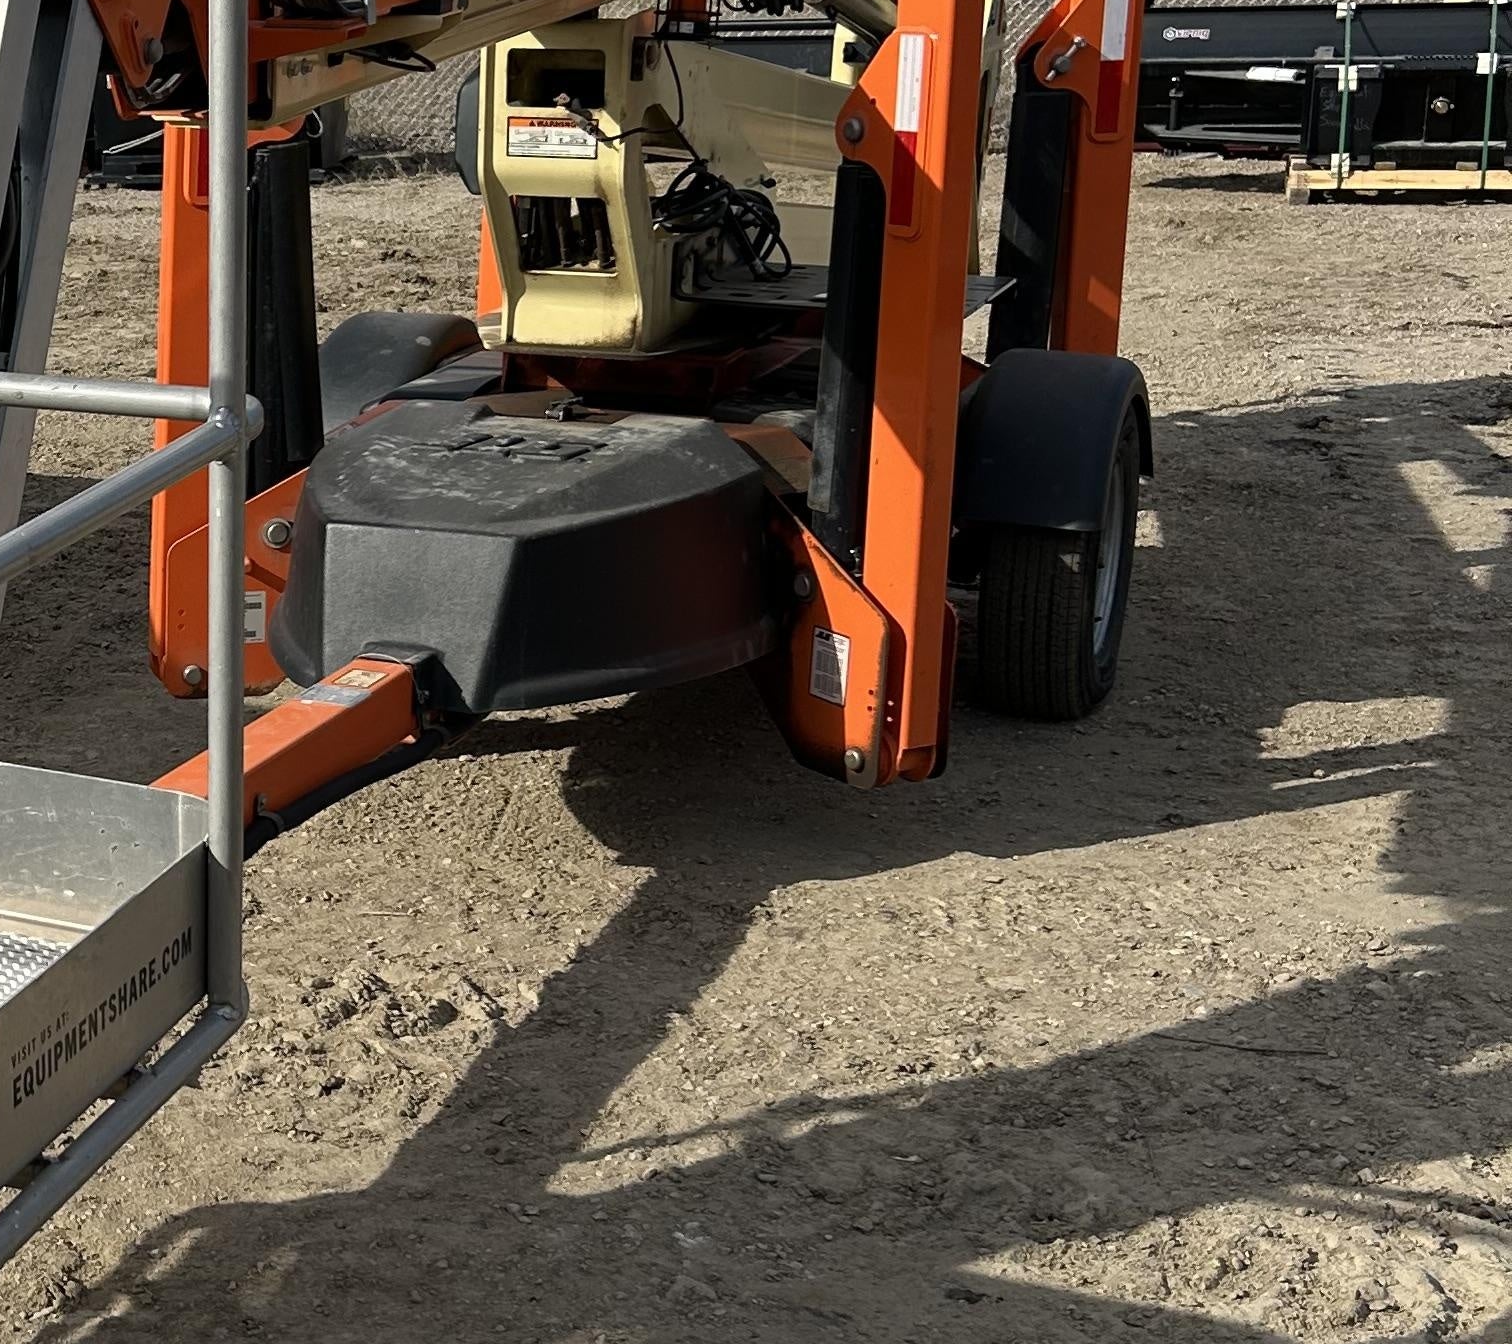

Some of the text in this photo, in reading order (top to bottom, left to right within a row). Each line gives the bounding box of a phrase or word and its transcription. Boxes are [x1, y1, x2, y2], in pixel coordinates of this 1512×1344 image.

[10, 1011, 69, 1068] VISIT US AT:
[12, 926, 192, 1108] EQUIPMENTSHARE.COM
